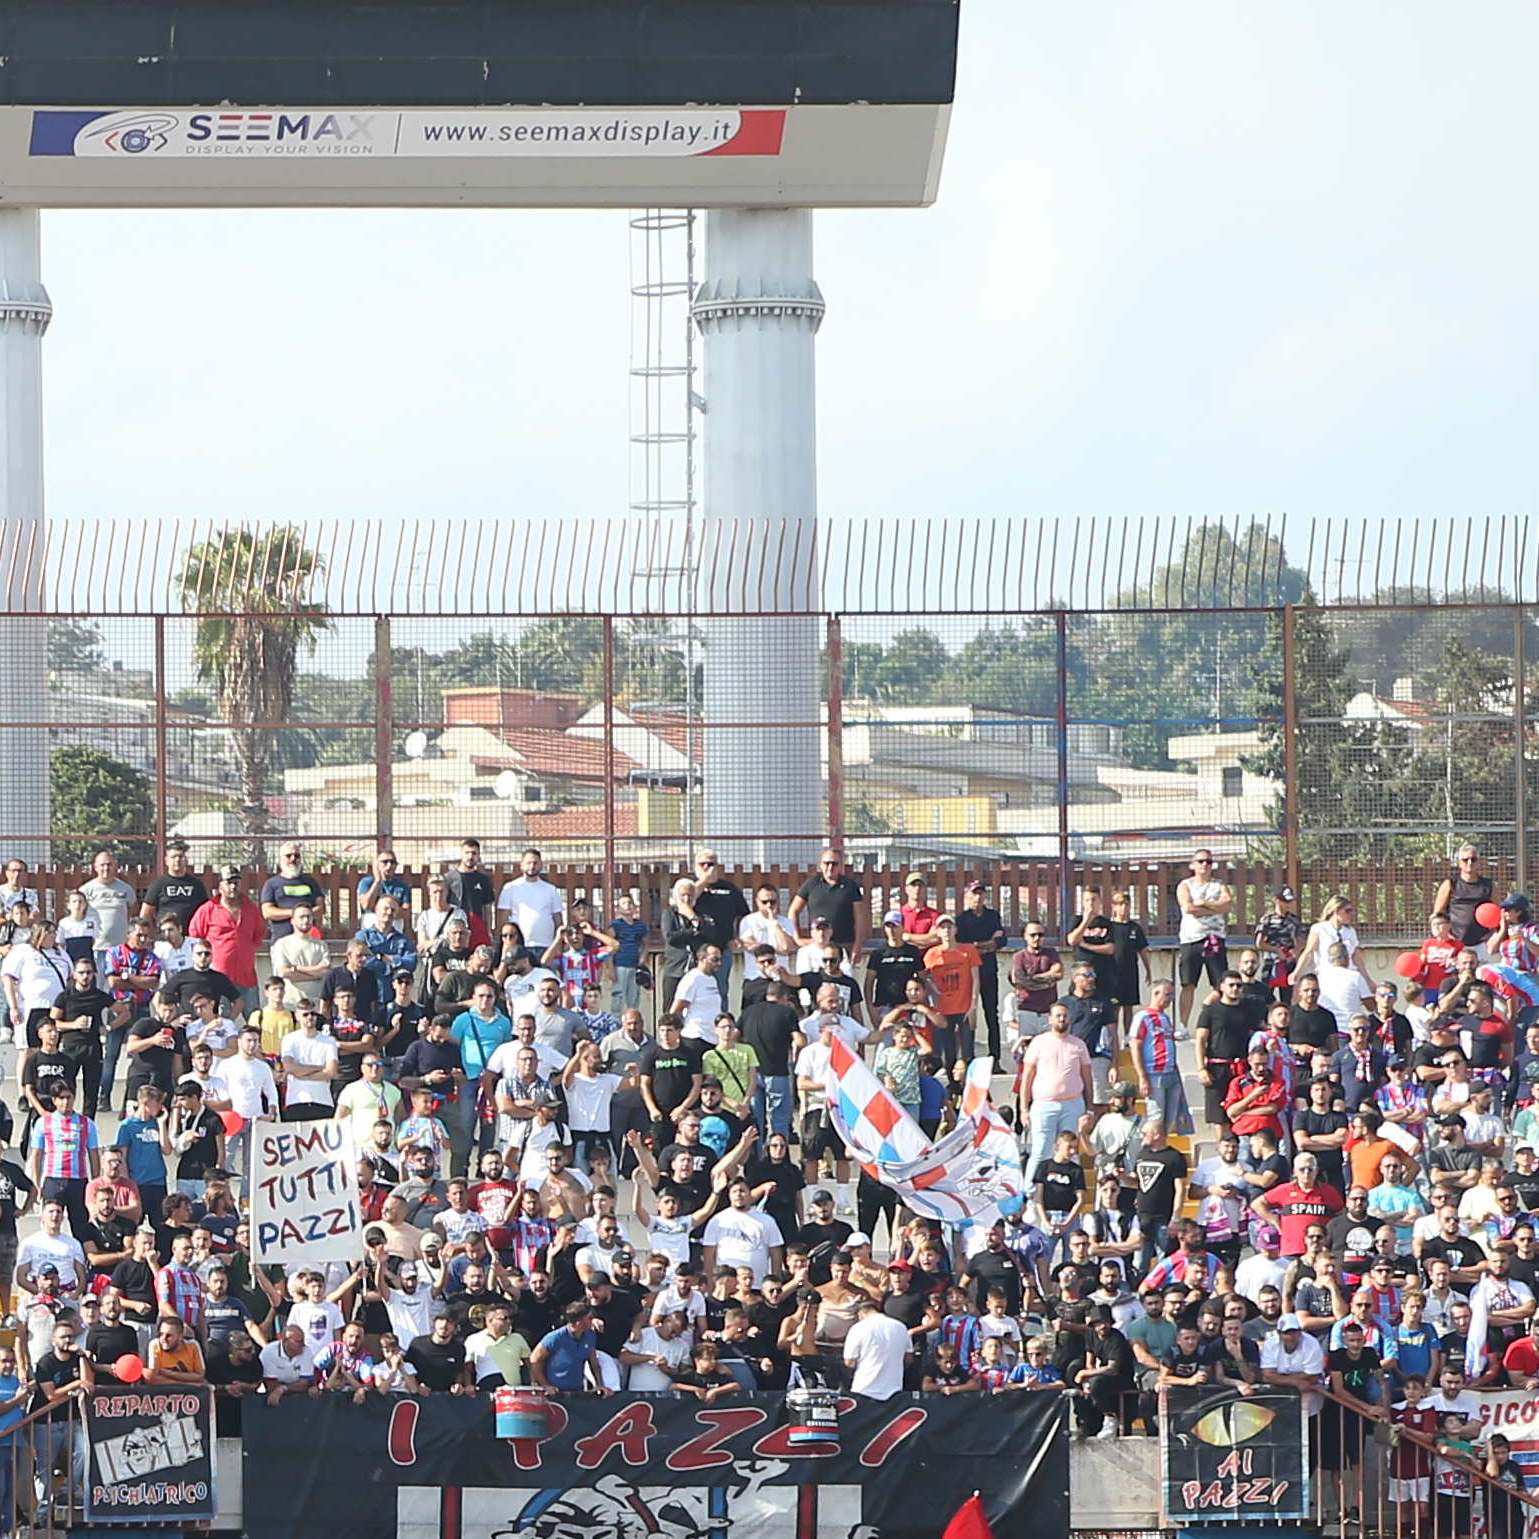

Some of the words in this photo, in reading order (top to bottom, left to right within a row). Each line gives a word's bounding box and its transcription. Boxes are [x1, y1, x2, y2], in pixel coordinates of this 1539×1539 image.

[186, 114, 375, 141] SEEMAX
[422, 116, 732, 148] www.seemaxdisplay.it
[185, 144, 253, 155] DISPLAY
[261, 144, 307, 155] YOUR
[314, 144, 374, 155] VISION
[167, 886, 193, 897] EA7
[262, 1124, 343, 1167] SEMU
[258, 1160, 347, 1211] TUTTI
[1291, 1204, 1326, 1216] SPAIN
[258, 1200, 357, 1256] PAZZI
[93, 1394, 200, 1418] REPARTO
[1218, 1449, 1253, 1479] AI
[93, 1481, 207, 1506] PSICHIATRICO
[1182, 1477, 1289, 1510] PAZZI
